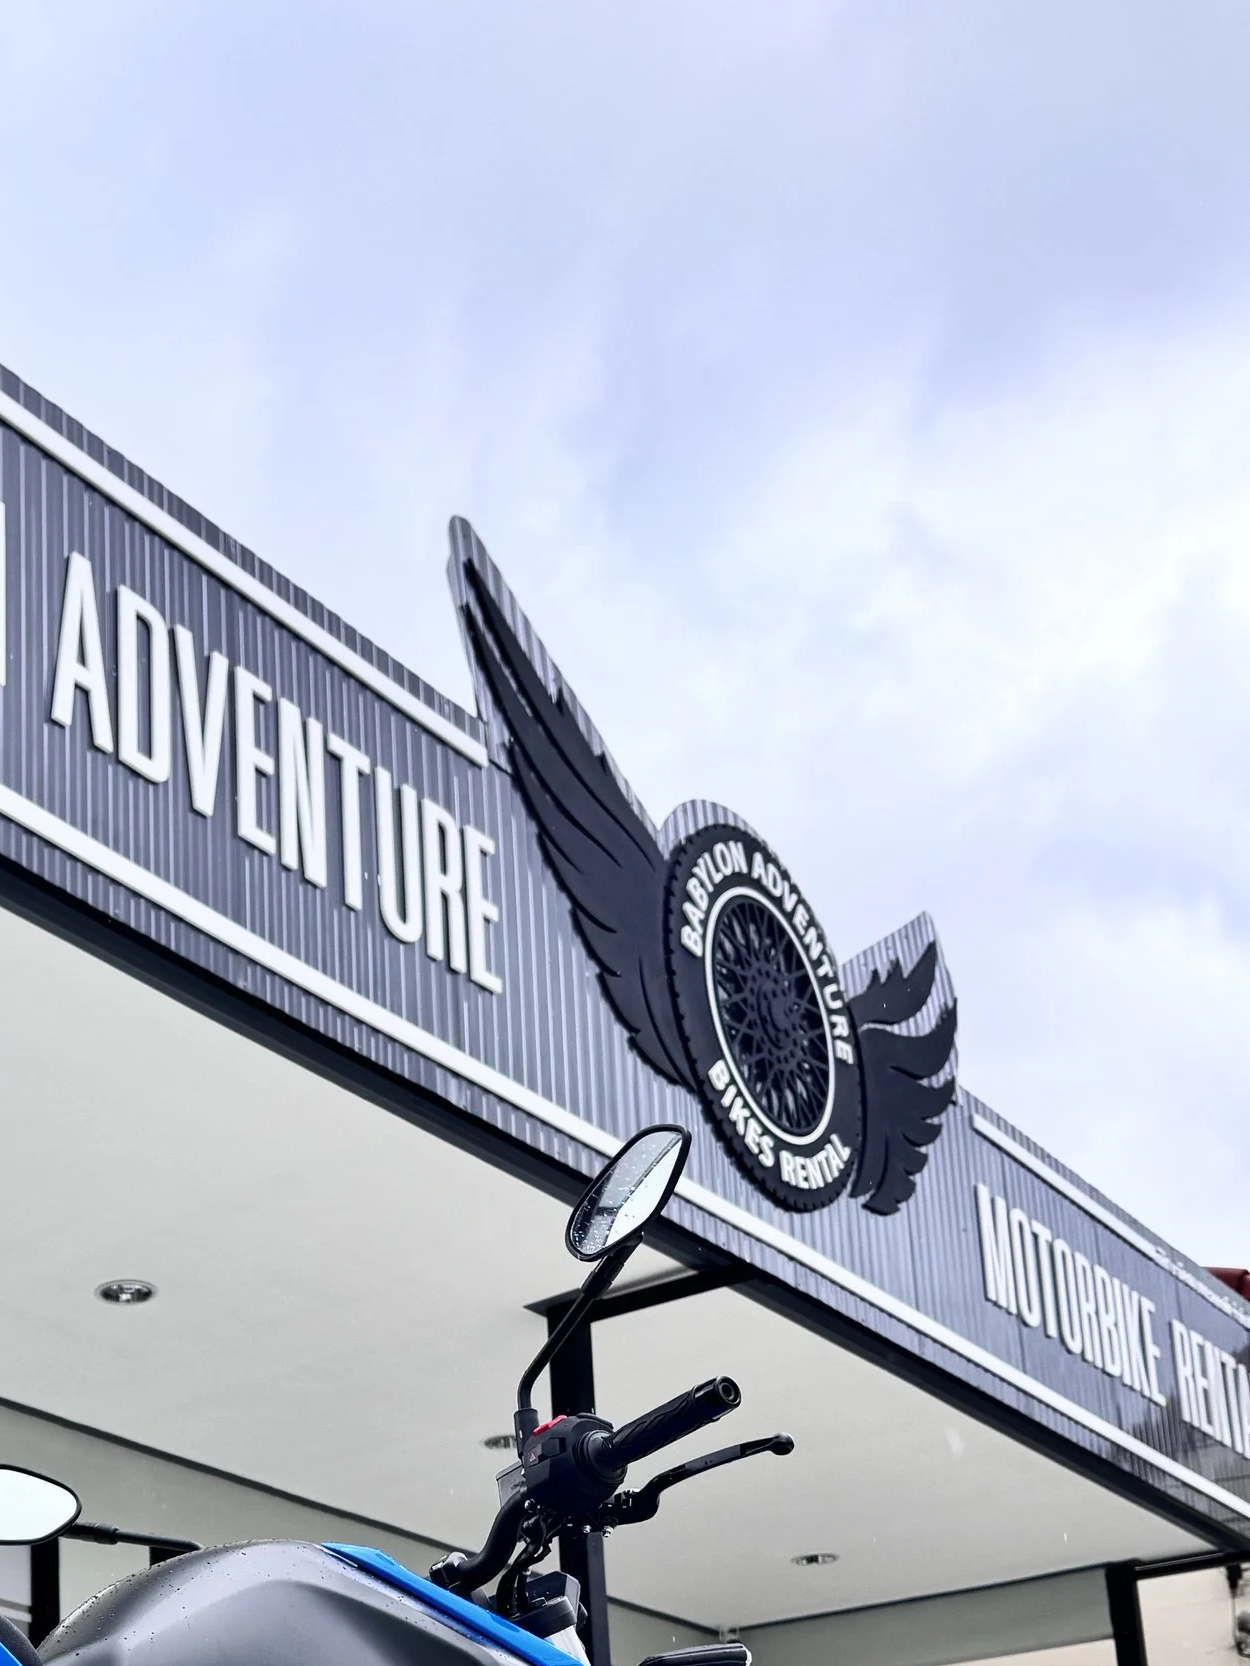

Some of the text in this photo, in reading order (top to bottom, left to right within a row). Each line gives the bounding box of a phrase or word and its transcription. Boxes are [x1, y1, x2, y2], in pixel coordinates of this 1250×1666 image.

[50, 550, 503, 995] ADVENTURE
[680, 839, 854, 1064] BABYLON ADVENTURE
[707, 1059, 851, 1191] BIKES RENTAL
[975, 1182, 1167, 1407] MOTORBIKE
